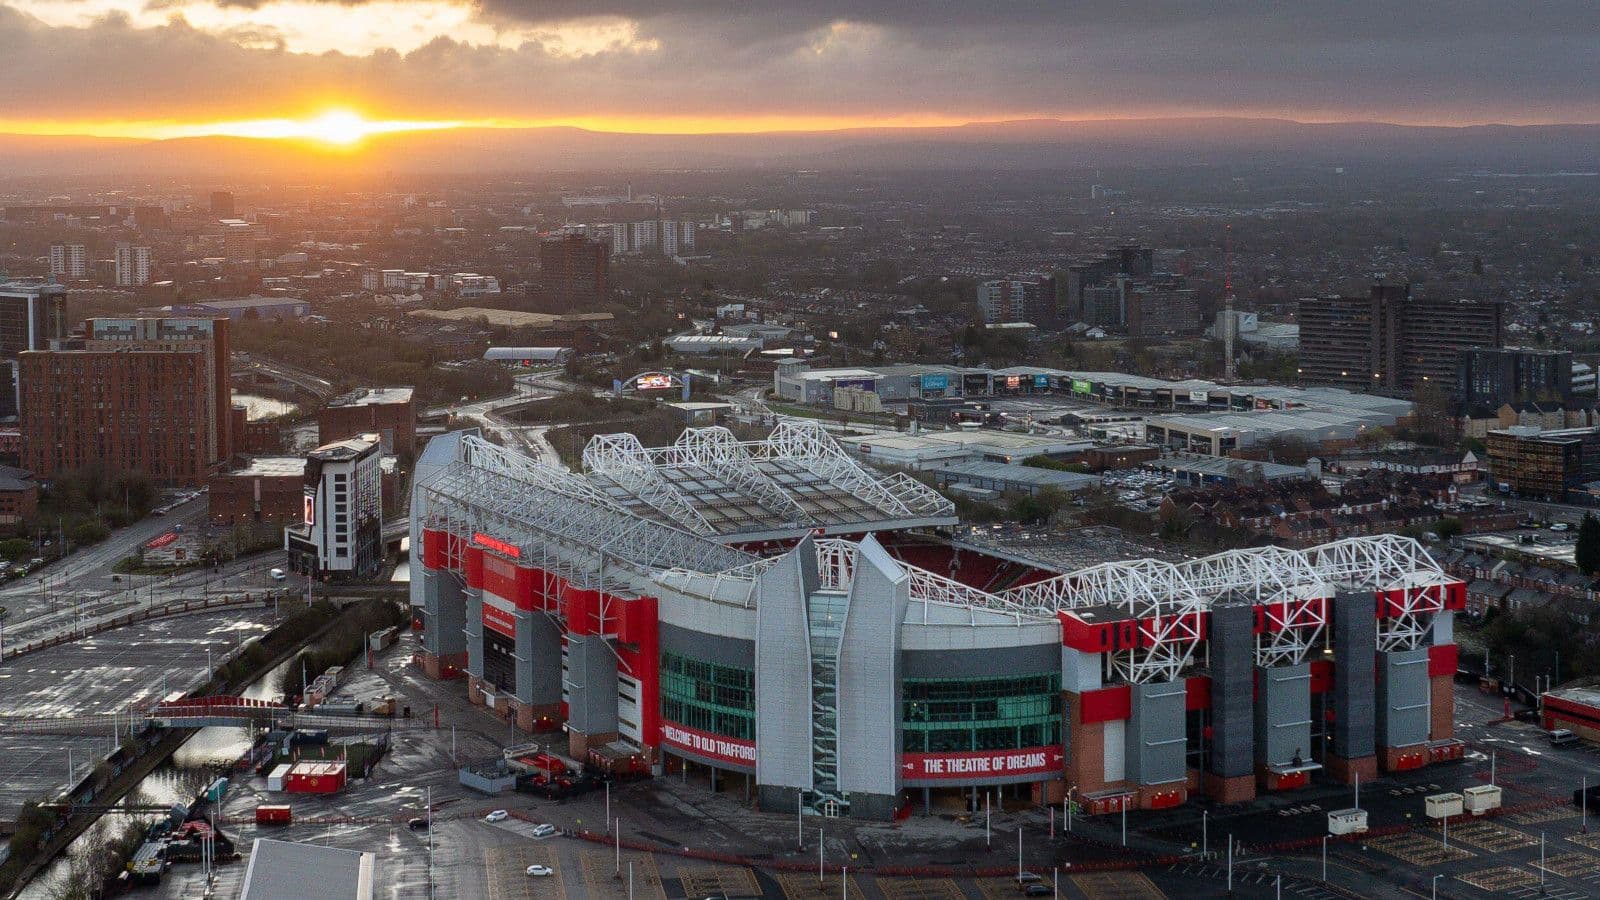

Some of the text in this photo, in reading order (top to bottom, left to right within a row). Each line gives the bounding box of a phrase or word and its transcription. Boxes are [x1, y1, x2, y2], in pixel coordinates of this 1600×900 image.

[664, 724, 756, 760] WELCOME TO OLD TRAFFORD
[923, 752, 1046, 773] THE THEATRE OF DREAMS
